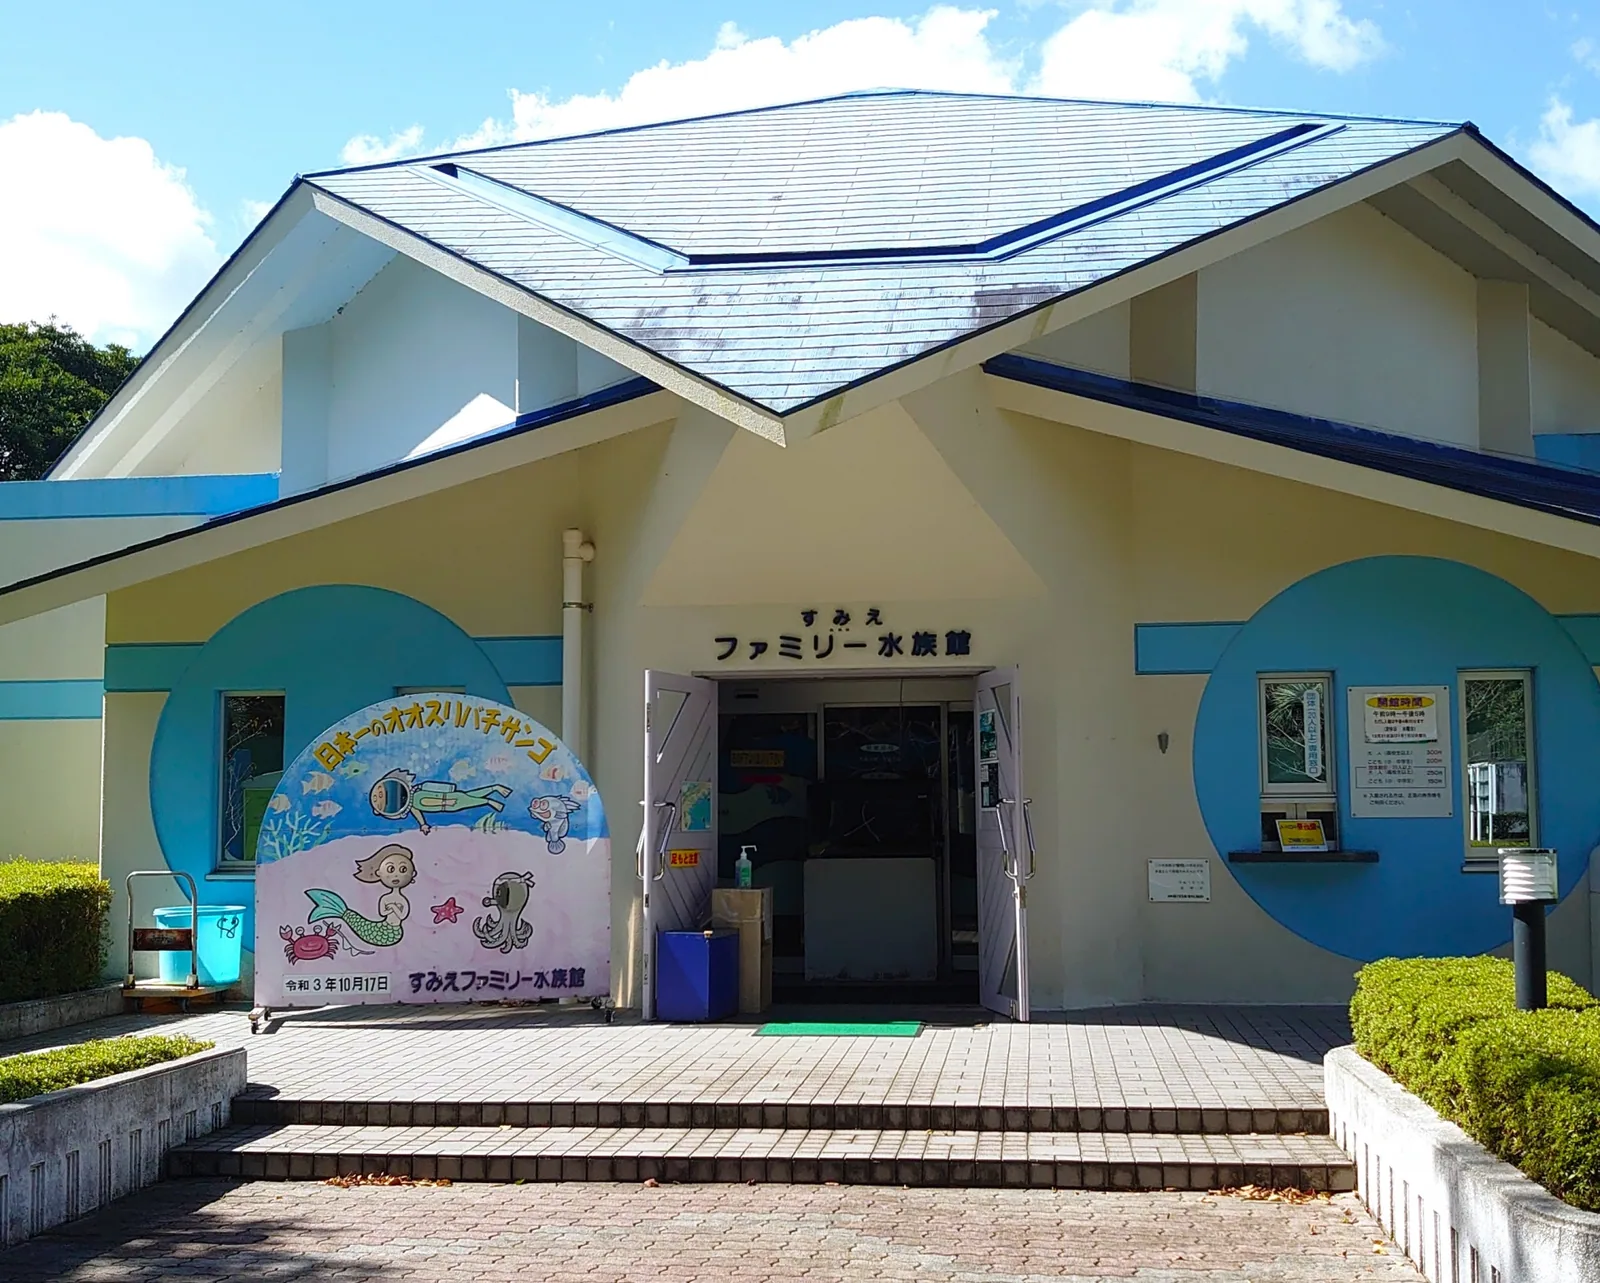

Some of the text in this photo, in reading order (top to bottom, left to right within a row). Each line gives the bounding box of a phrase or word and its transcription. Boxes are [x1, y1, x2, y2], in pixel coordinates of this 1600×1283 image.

[801, 608, 883, 627] すみえ
[714, 630, 972, 660] ファミリー水族館
[313, 700, 558, 772] 日本一のオオスリバチサンゴ
[671, 852, 698, 865] 足もと注意
[285, 975, 389, 993] 令和3年10月17日
[408, 967, 586, 994] すみえファミリー水族館
